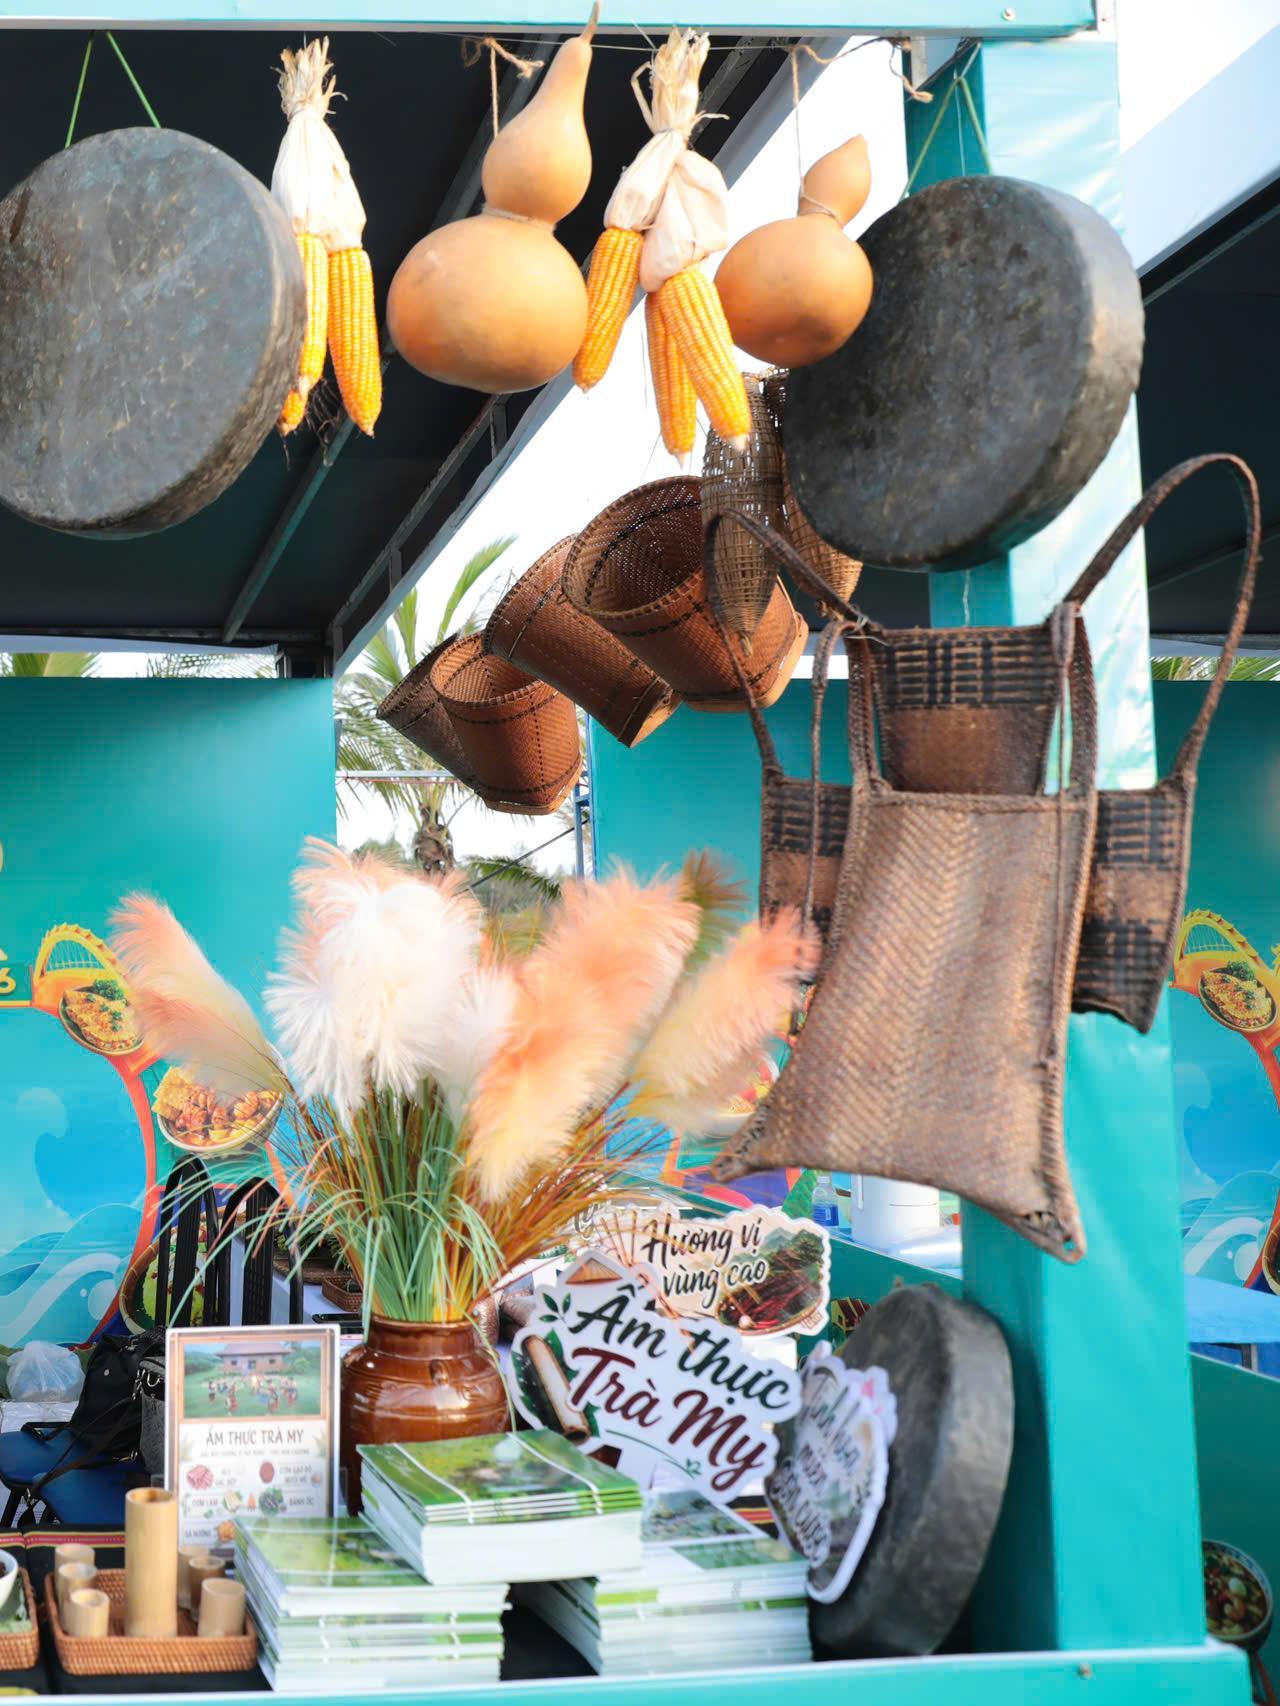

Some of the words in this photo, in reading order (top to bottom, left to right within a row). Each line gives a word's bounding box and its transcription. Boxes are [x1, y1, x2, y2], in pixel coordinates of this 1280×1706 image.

[641, 1213, 733, 1268] Hương
[741, 1217, 762, 1257] vị
[663, 1263, 719, 1310] vùng
[727, 1260, 766, 1287] cao
[678, 1328, 790, 1410] thực
[261, 1426, 283, 1444] TRÀ
[287, 1429, 304, 1444] MY
[571, 1347, 664, 1428] Trà
[667, 1389, 767, 1492] My
